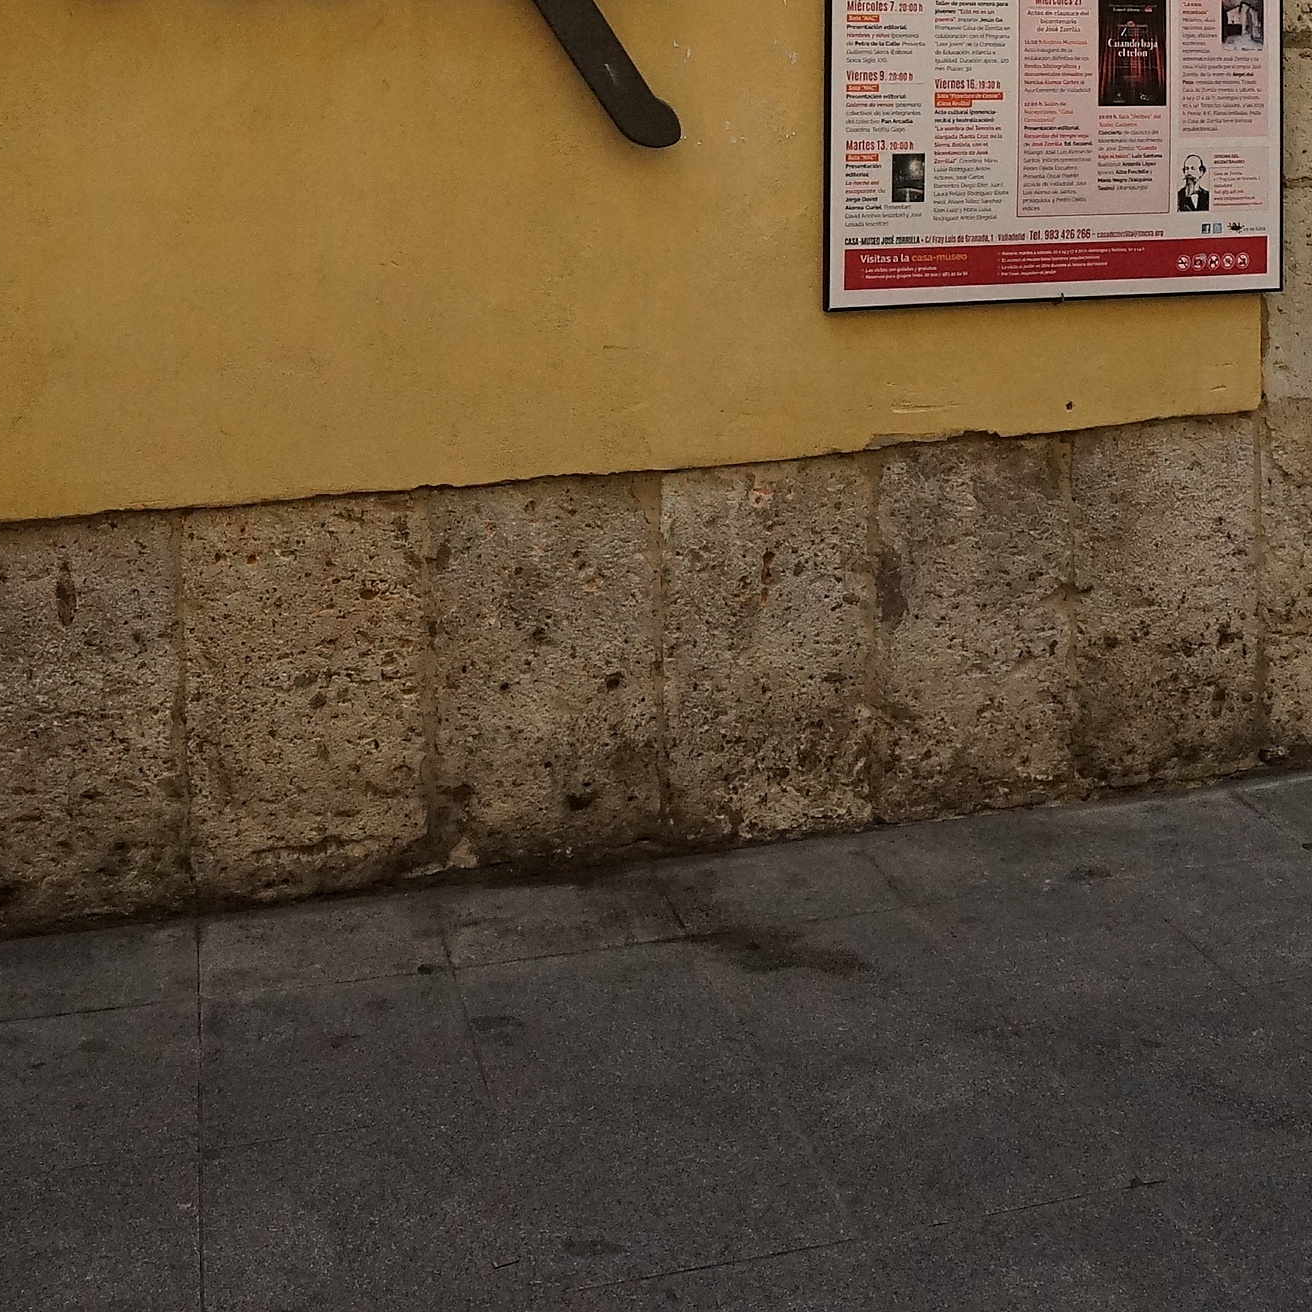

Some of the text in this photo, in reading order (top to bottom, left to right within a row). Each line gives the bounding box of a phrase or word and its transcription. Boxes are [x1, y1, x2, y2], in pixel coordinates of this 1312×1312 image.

[847, 0, 887, 12] Miércoles
[899, 3, 918, 12] 20:00
[919, 3, 923, 12] h
[846, 70, 878, 82] Viernes
[889, 73, 907, 81] 20:00
[909, 73, 913, 81] h
[935, 78, 965, 89] Viernes
[978, 80, 995, 89] 19:30
[996, 81, 1001, 89] h
[846, 140, 875, 151] Martes
[890, 141, 908, 150] 20:00
[909, 142, 914, 150] h
[881, 235, 894, 245] JOSÉ
[1045, 230, 1059, 240] 983
[1060, 229, 1075, 240] 426
[1077, 229, 1091, 239] 266
[860, 254, 891, 263] Visitas
[901, 254, 909, 262] la
[912, 253, 967, 262] casa-museo
